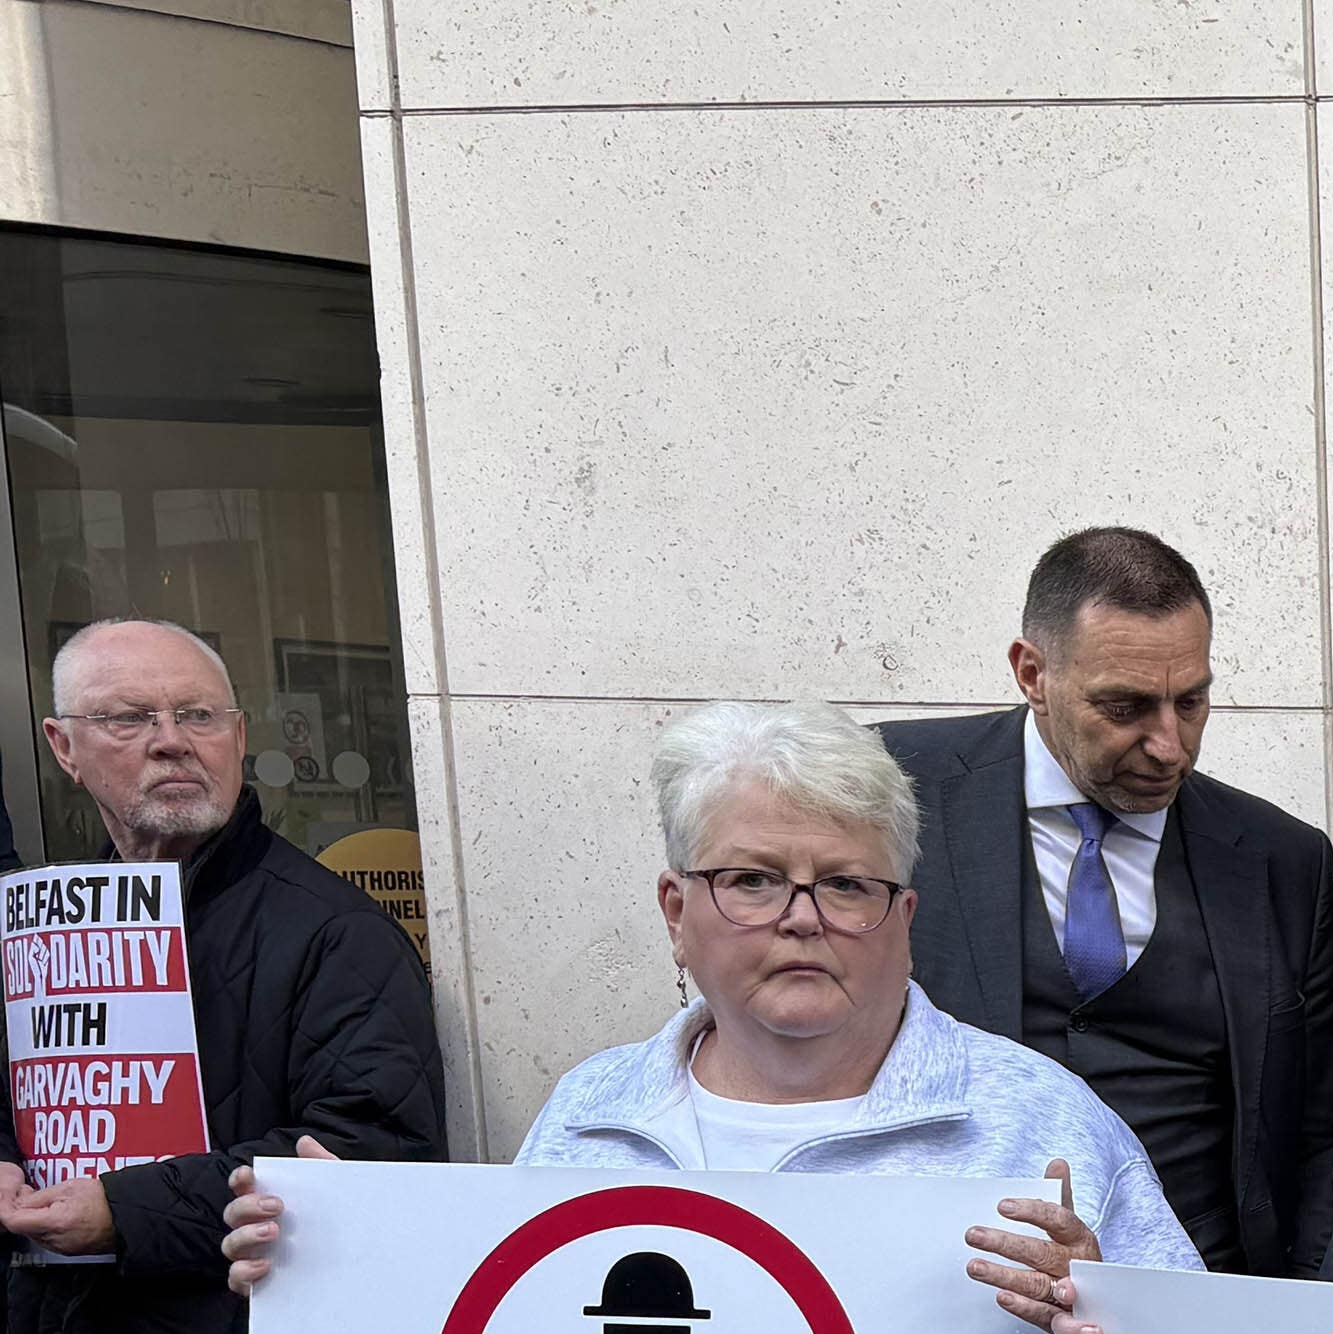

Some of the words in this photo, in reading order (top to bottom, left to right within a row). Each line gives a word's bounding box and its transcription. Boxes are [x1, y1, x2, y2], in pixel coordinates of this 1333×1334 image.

[6, 876, 110, 933] BELFAST
[117, 874, 162, 922] IN
[31, 1002, 108, 1049] WITH
[15, 1060, 176, 1110] GARVAGHY
[34, 1109, 117, 1155] ROAD
